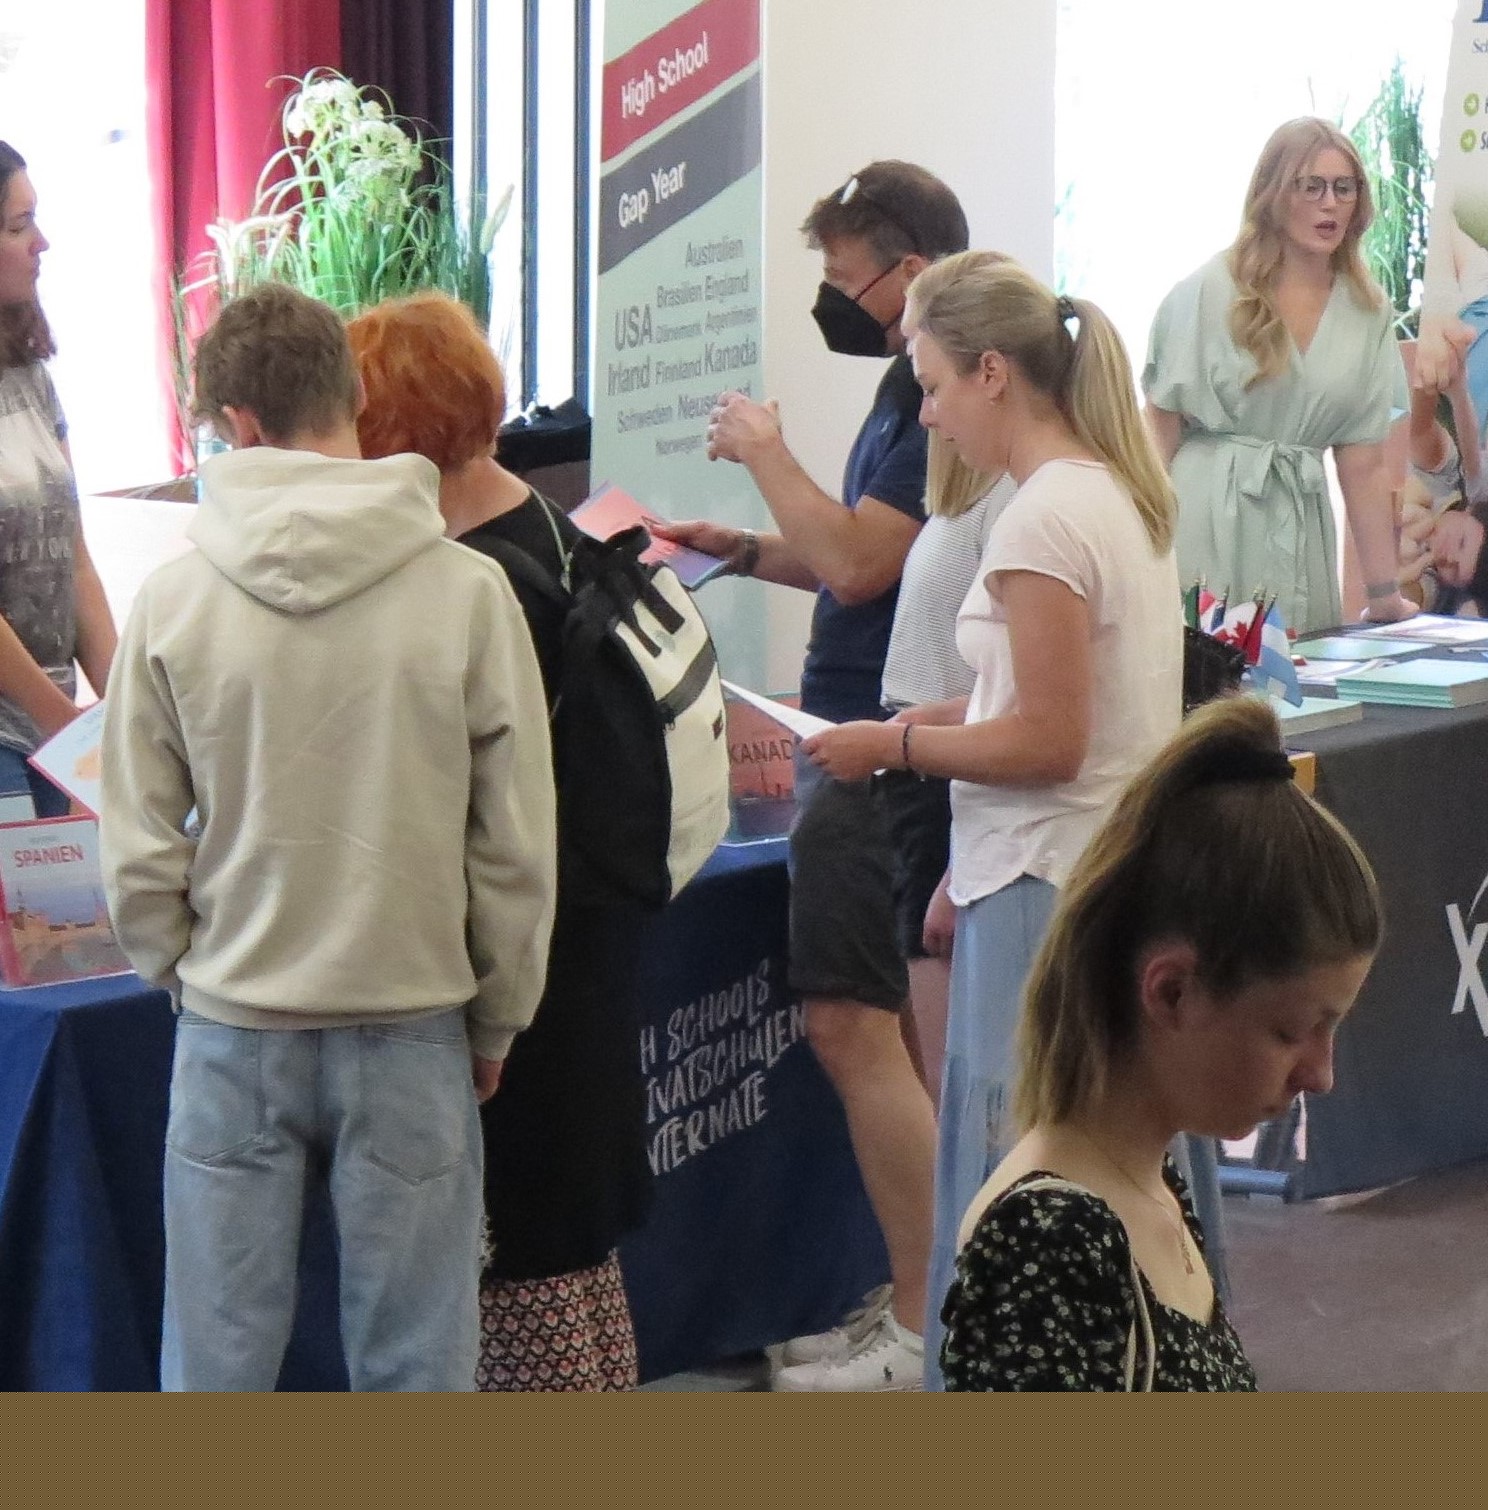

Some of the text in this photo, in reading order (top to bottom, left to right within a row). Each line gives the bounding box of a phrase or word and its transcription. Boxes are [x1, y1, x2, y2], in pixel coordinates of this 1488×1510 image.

[622, 31, 709, 119] High School
[619, 162, 686, 228] Gap Year
[686, 236, 743, 268] Australien
[657, 268, 749, 308] Brasilien England
[615, 304, 652, 350] USA
[608, 335, 757, 396] Irland Finnland Kanada
[617, 405, 673, 433] Schweden
[731, 738, 793, 764] KANAD
[14, 843, 84, 868] SPANIEN
[667, 957, 770, 1062] SCHOOLS
[646, 1003, 807, 1124] IVATSCHULEN
[647, 1070, 768, 1176] NTERNATE
